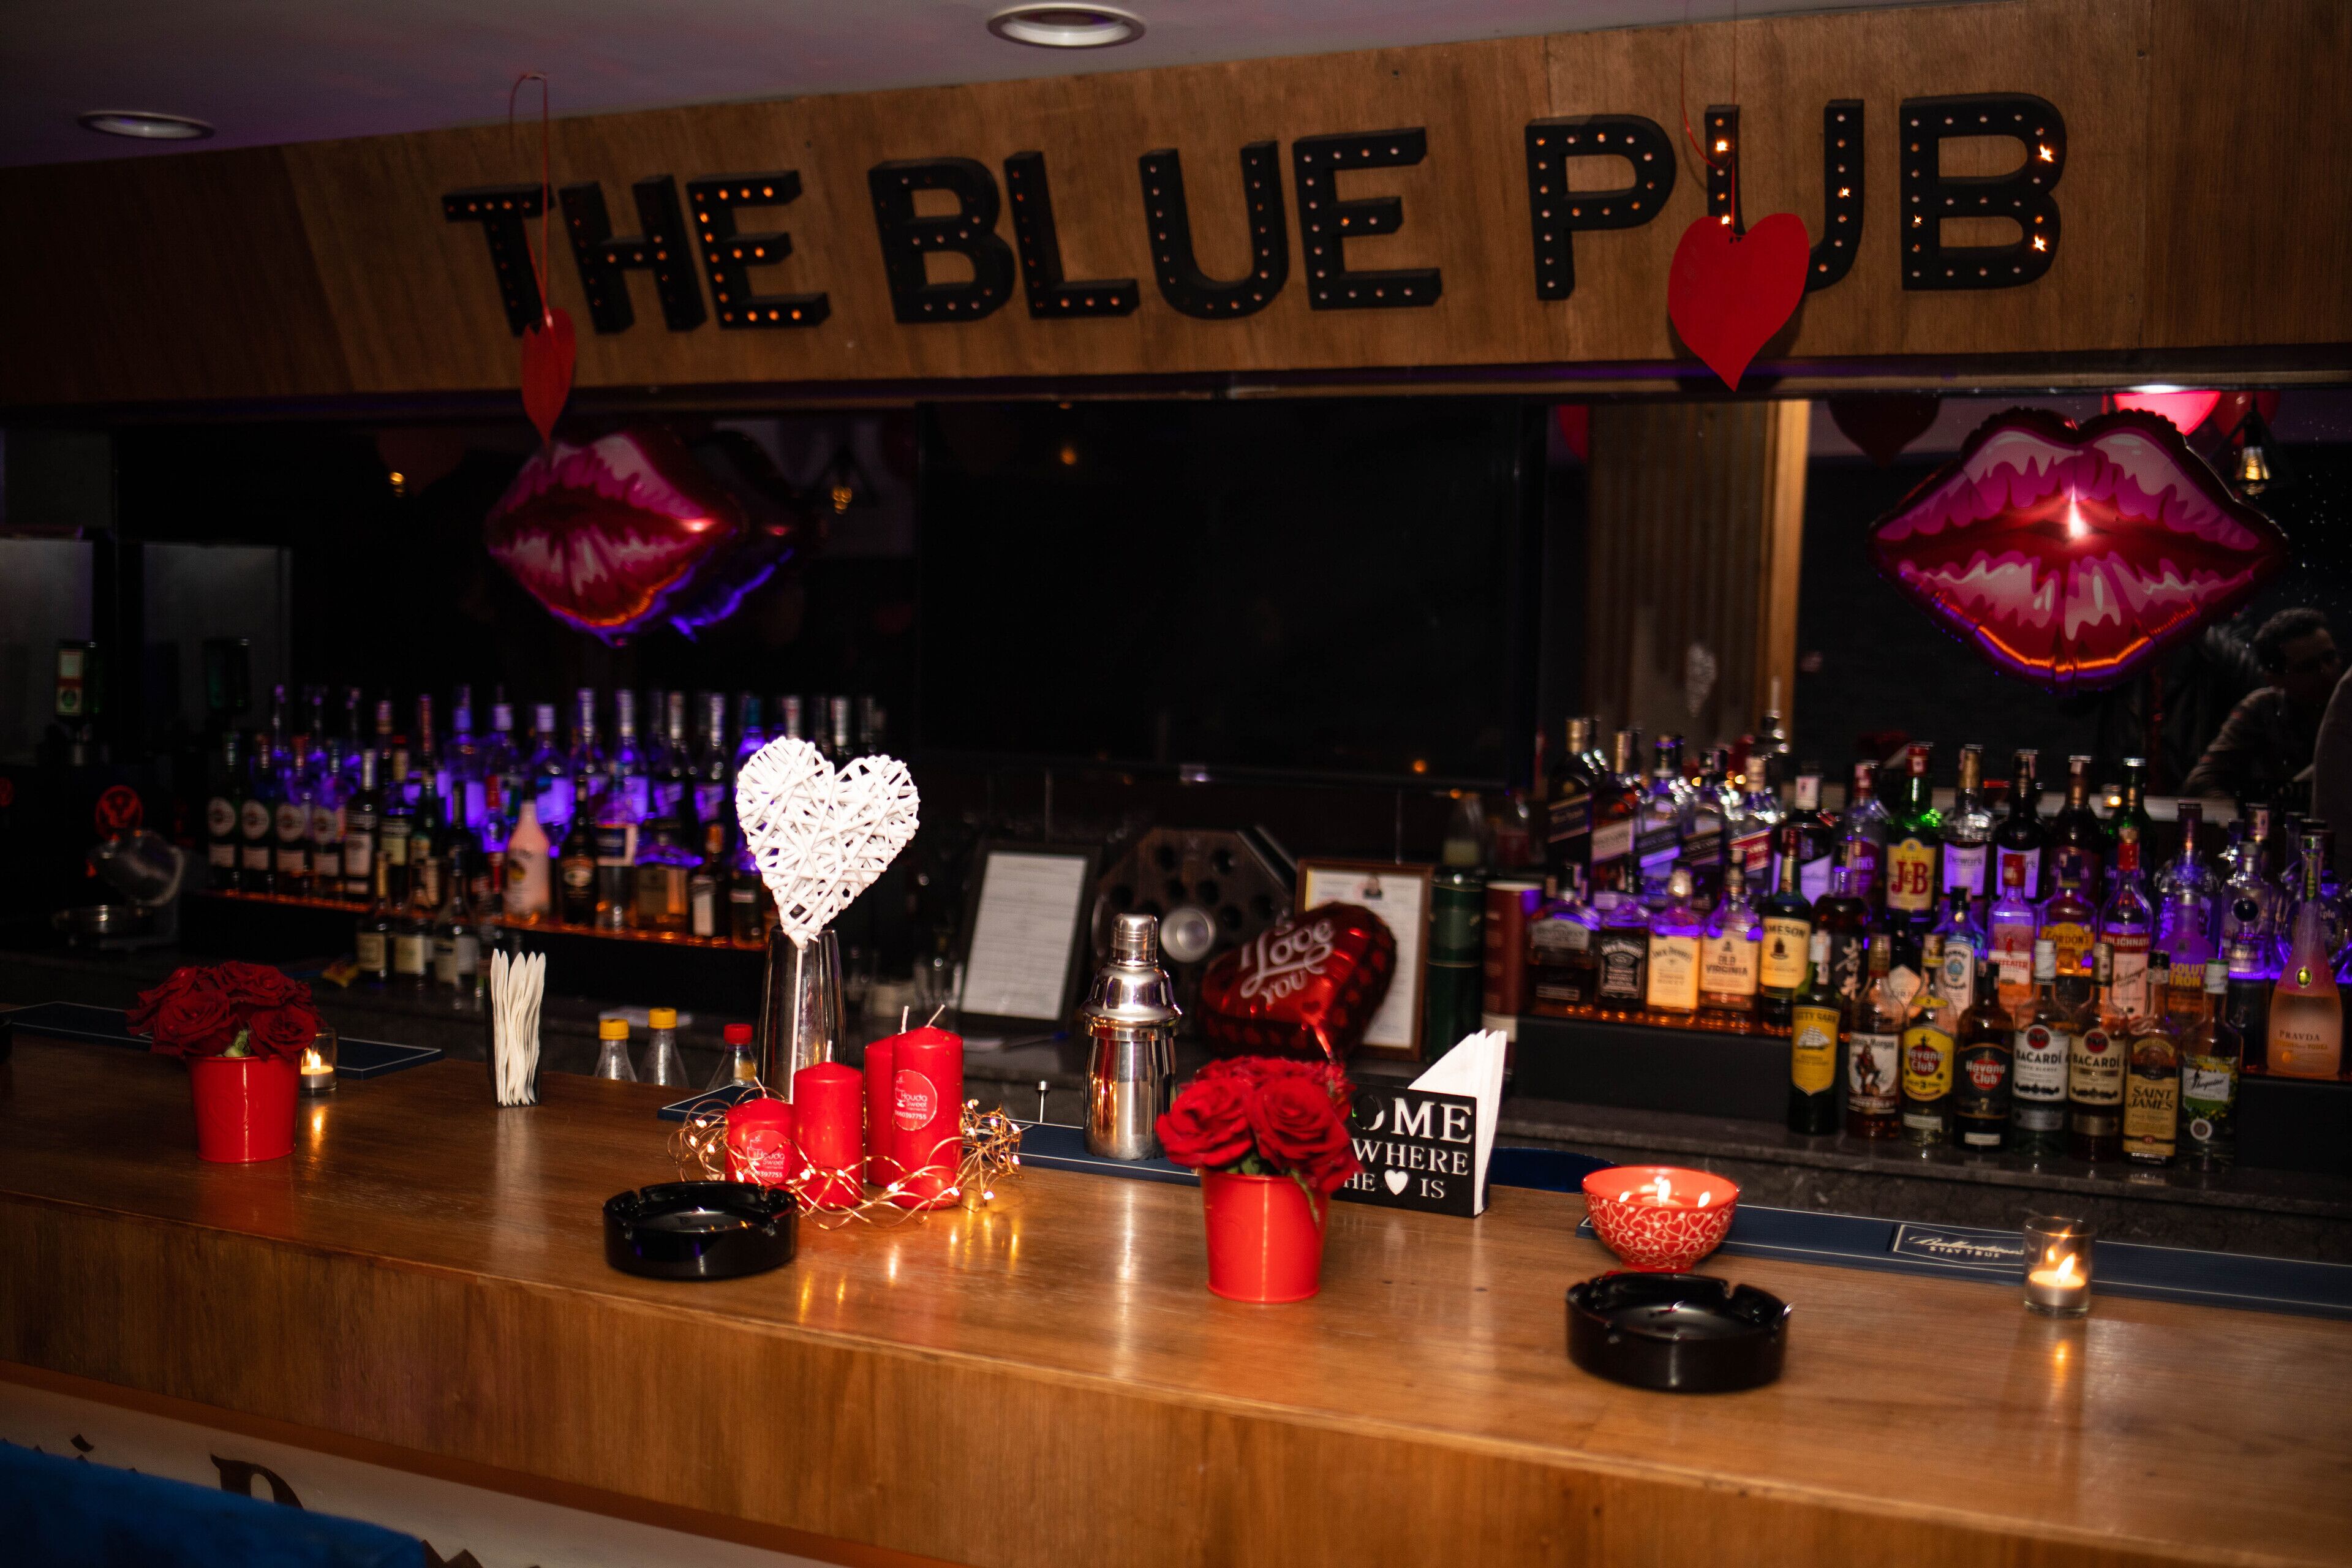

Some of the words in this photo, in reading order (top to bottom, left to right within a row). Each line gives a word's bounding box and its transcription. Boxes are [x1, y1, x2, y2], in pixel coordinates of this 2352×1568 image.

[441, 170, 831, 337] THE
[868, 127, 1442, 323] BLUE
[1525, 92, 2067, 300] PUB
[1240, 943, 1251, 971] I
[2279, 1030, 2320, 1041] PRAVDA
[1911, 1060, 1936, 1072] Club
[1966, 1060, 2006, 1074] Havana
[1973, 1072, 1997, 1085] Club
[901, 1091, 928, 1102] Houda
[2133, 1085, 2174, 1099] SAINT
[2128, 1097, 2173, 1111] JAMES
[1351, 1095, 1472, 1144] OME
[1351, 1137, 1469, 1176] WHERE
[1344, 1172, 1376, 1192] HE
[1419, 1178, 1446, 1199] IS
